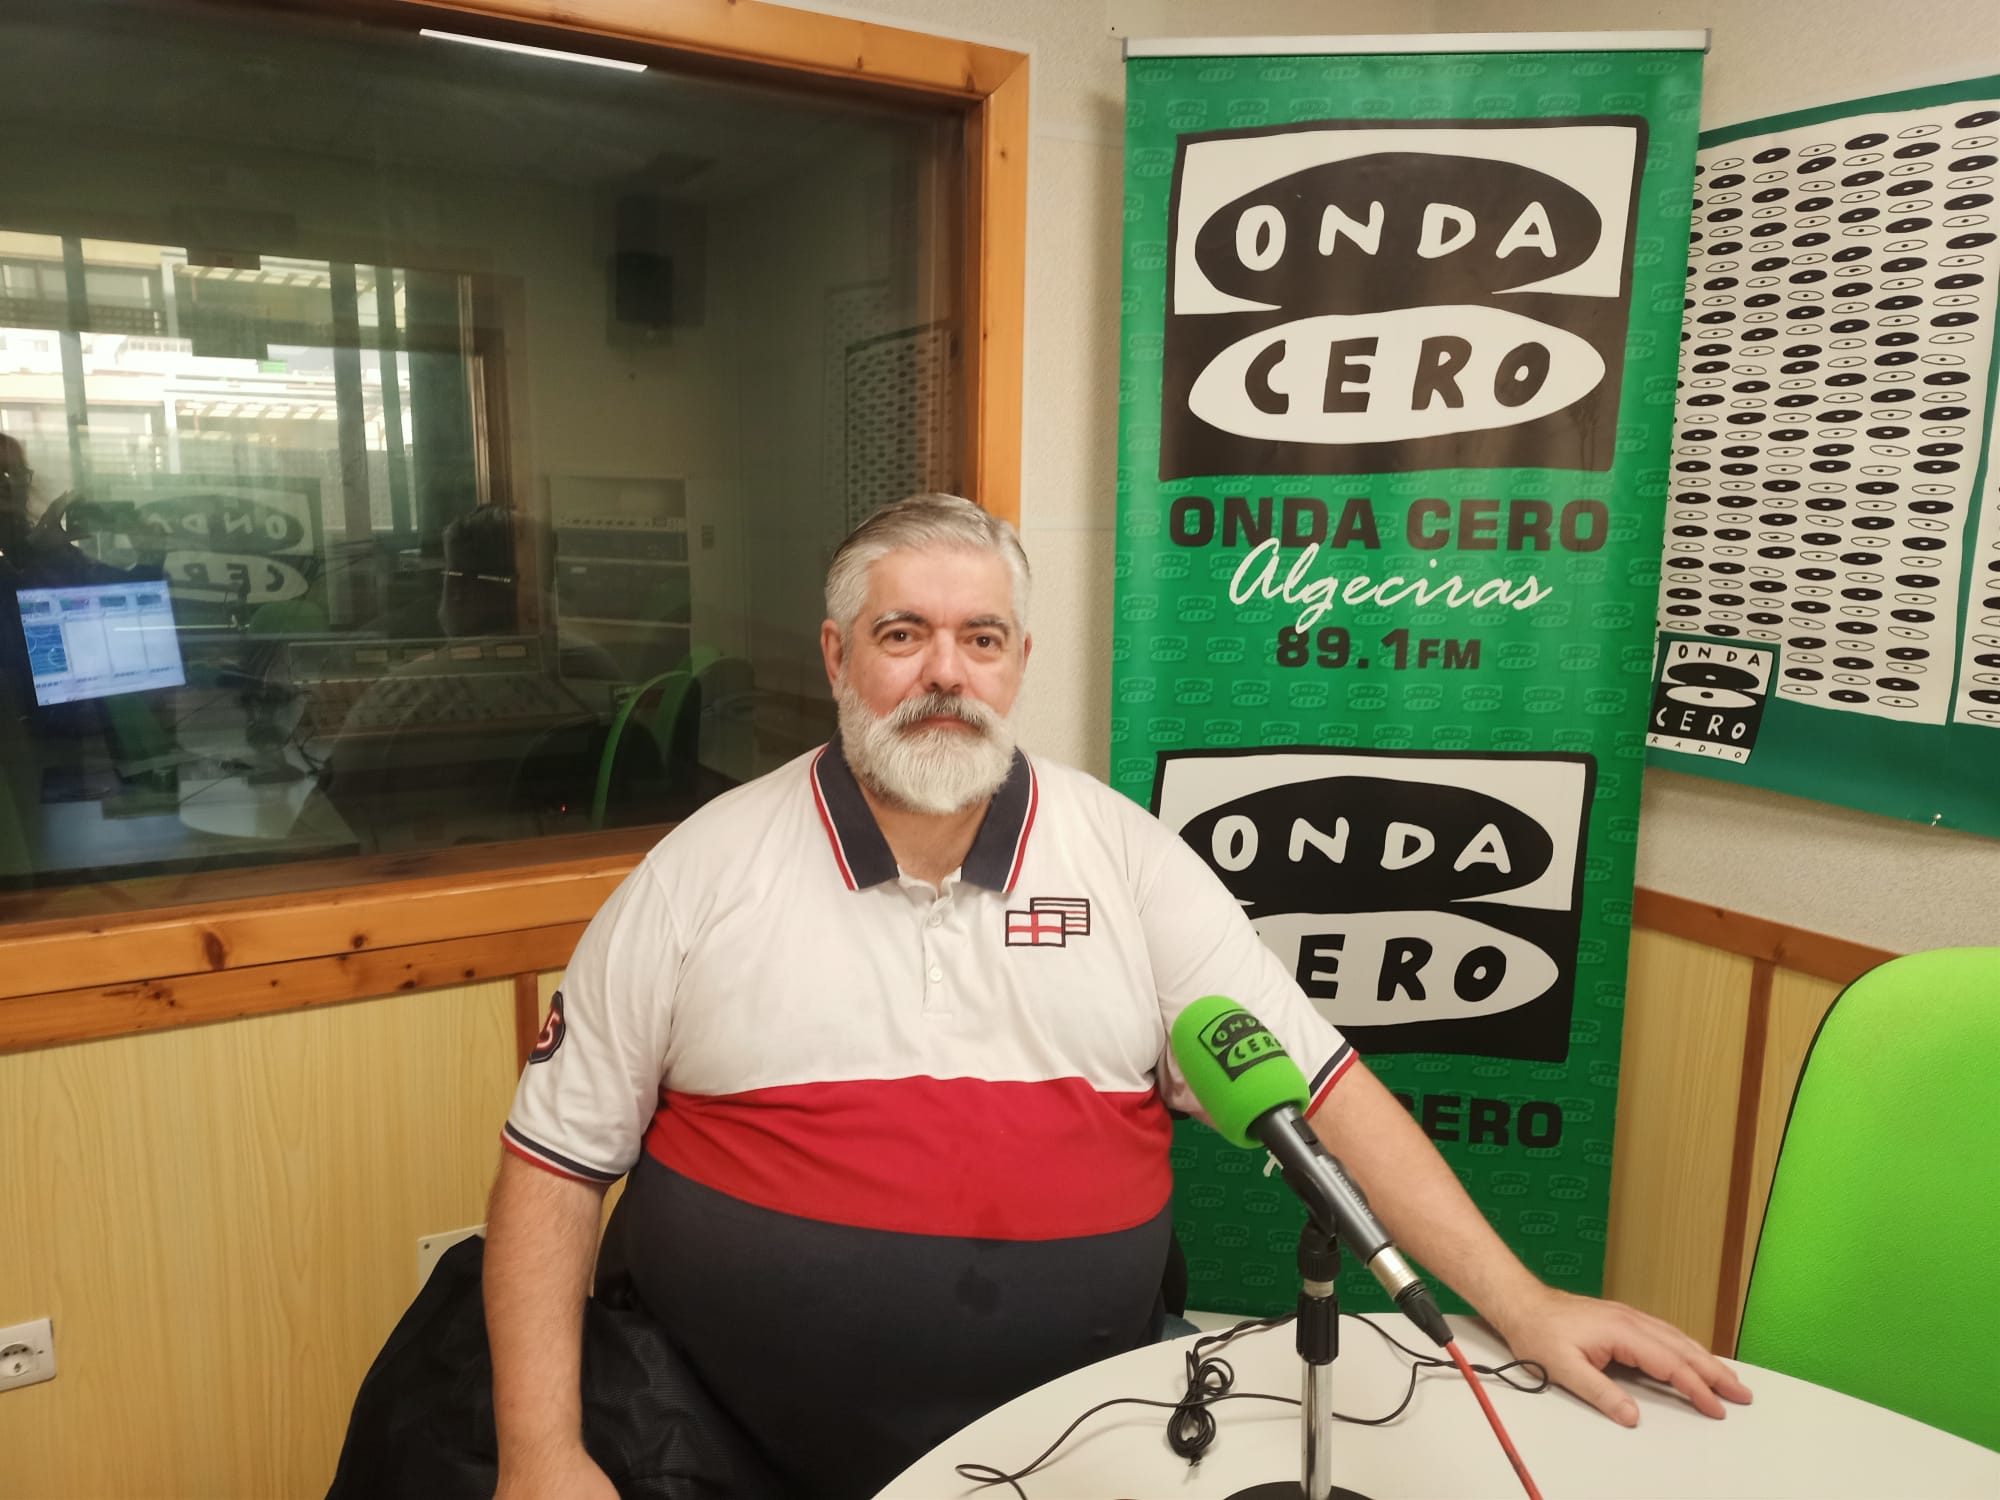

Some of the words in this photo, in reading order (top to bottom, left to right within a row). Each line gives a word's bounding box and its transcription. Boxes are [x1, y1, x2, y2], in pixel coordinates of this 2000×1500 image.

[1235, 200, 1557, 271] ONDA
[1244, 335, 1551, 415] CERO
[1168, 496, 1381, 549] ONDA
[1406, 497, 1609, 553] CERO
[1228, 537, 1553, 634] Algeciras
[1678, 645, 1760, 666] ONDA
[1651, 737, 1742, 759] RADIO
[1656, 707, 1746, 739] CERO
[1211, 815, 1511, 873] ONDA
[1256, 930, 1508, 1003] ERO
[1215, 1017, 1262, 1042] OND
[1393, 1092, 1563, 1149] ERO
